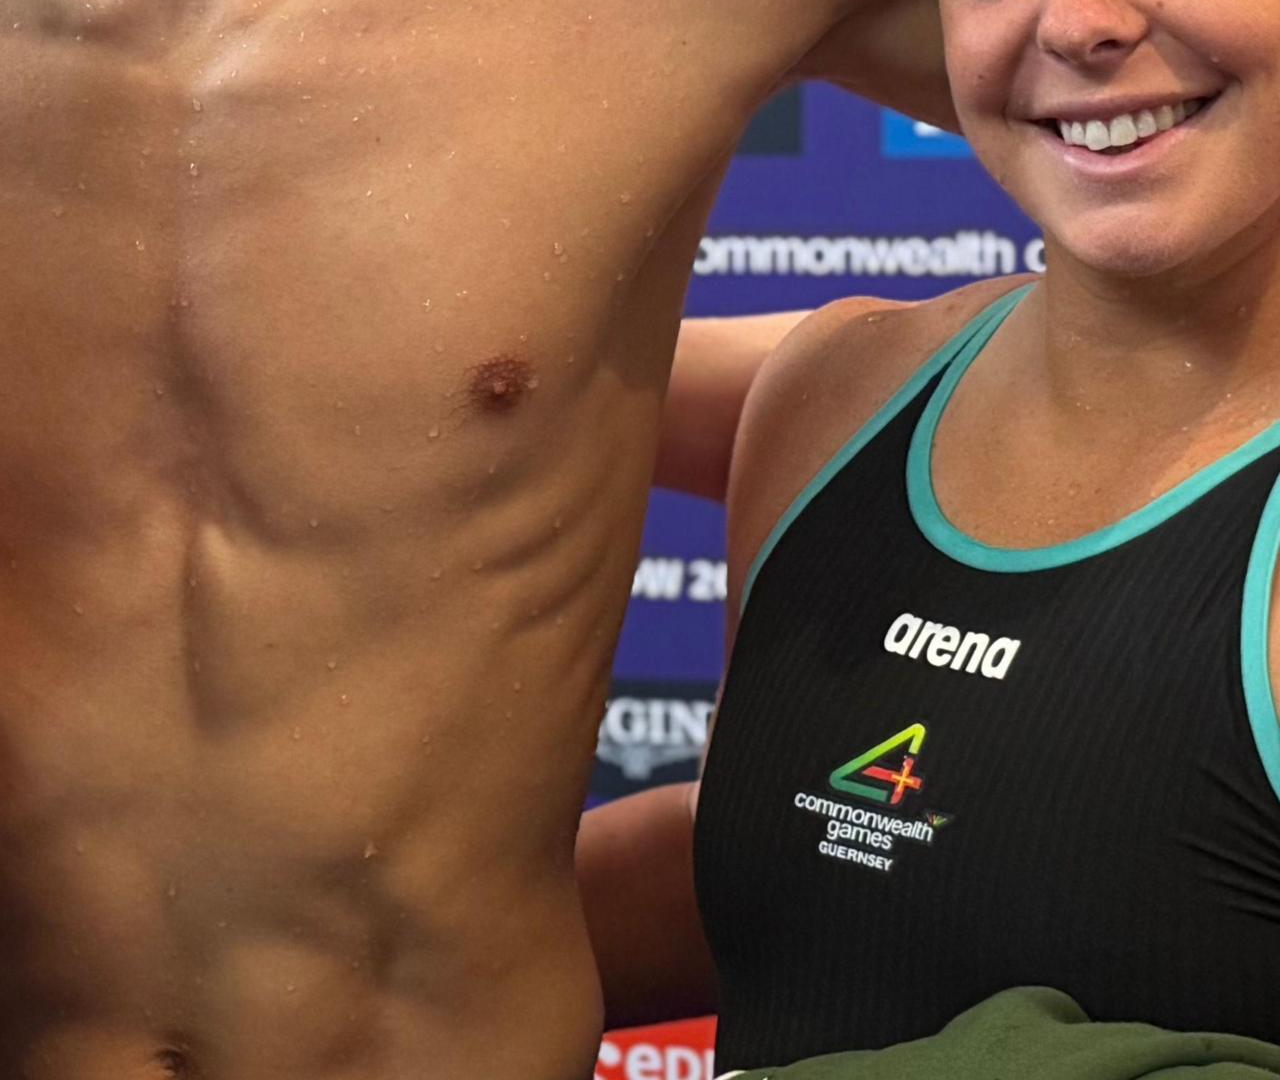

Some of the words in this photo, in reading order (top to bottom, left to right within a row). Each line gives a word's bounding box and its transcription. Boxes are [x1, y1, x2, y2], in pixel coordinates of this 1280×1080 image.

[693, 232, 1016, 274] ommonwealth
[883, 612, 1021, 680] arena
[794, 791, 934, 843] commonwealth
[826, 818, 894, 850] games
[818, 840, 894, 871] GUERNSEY
